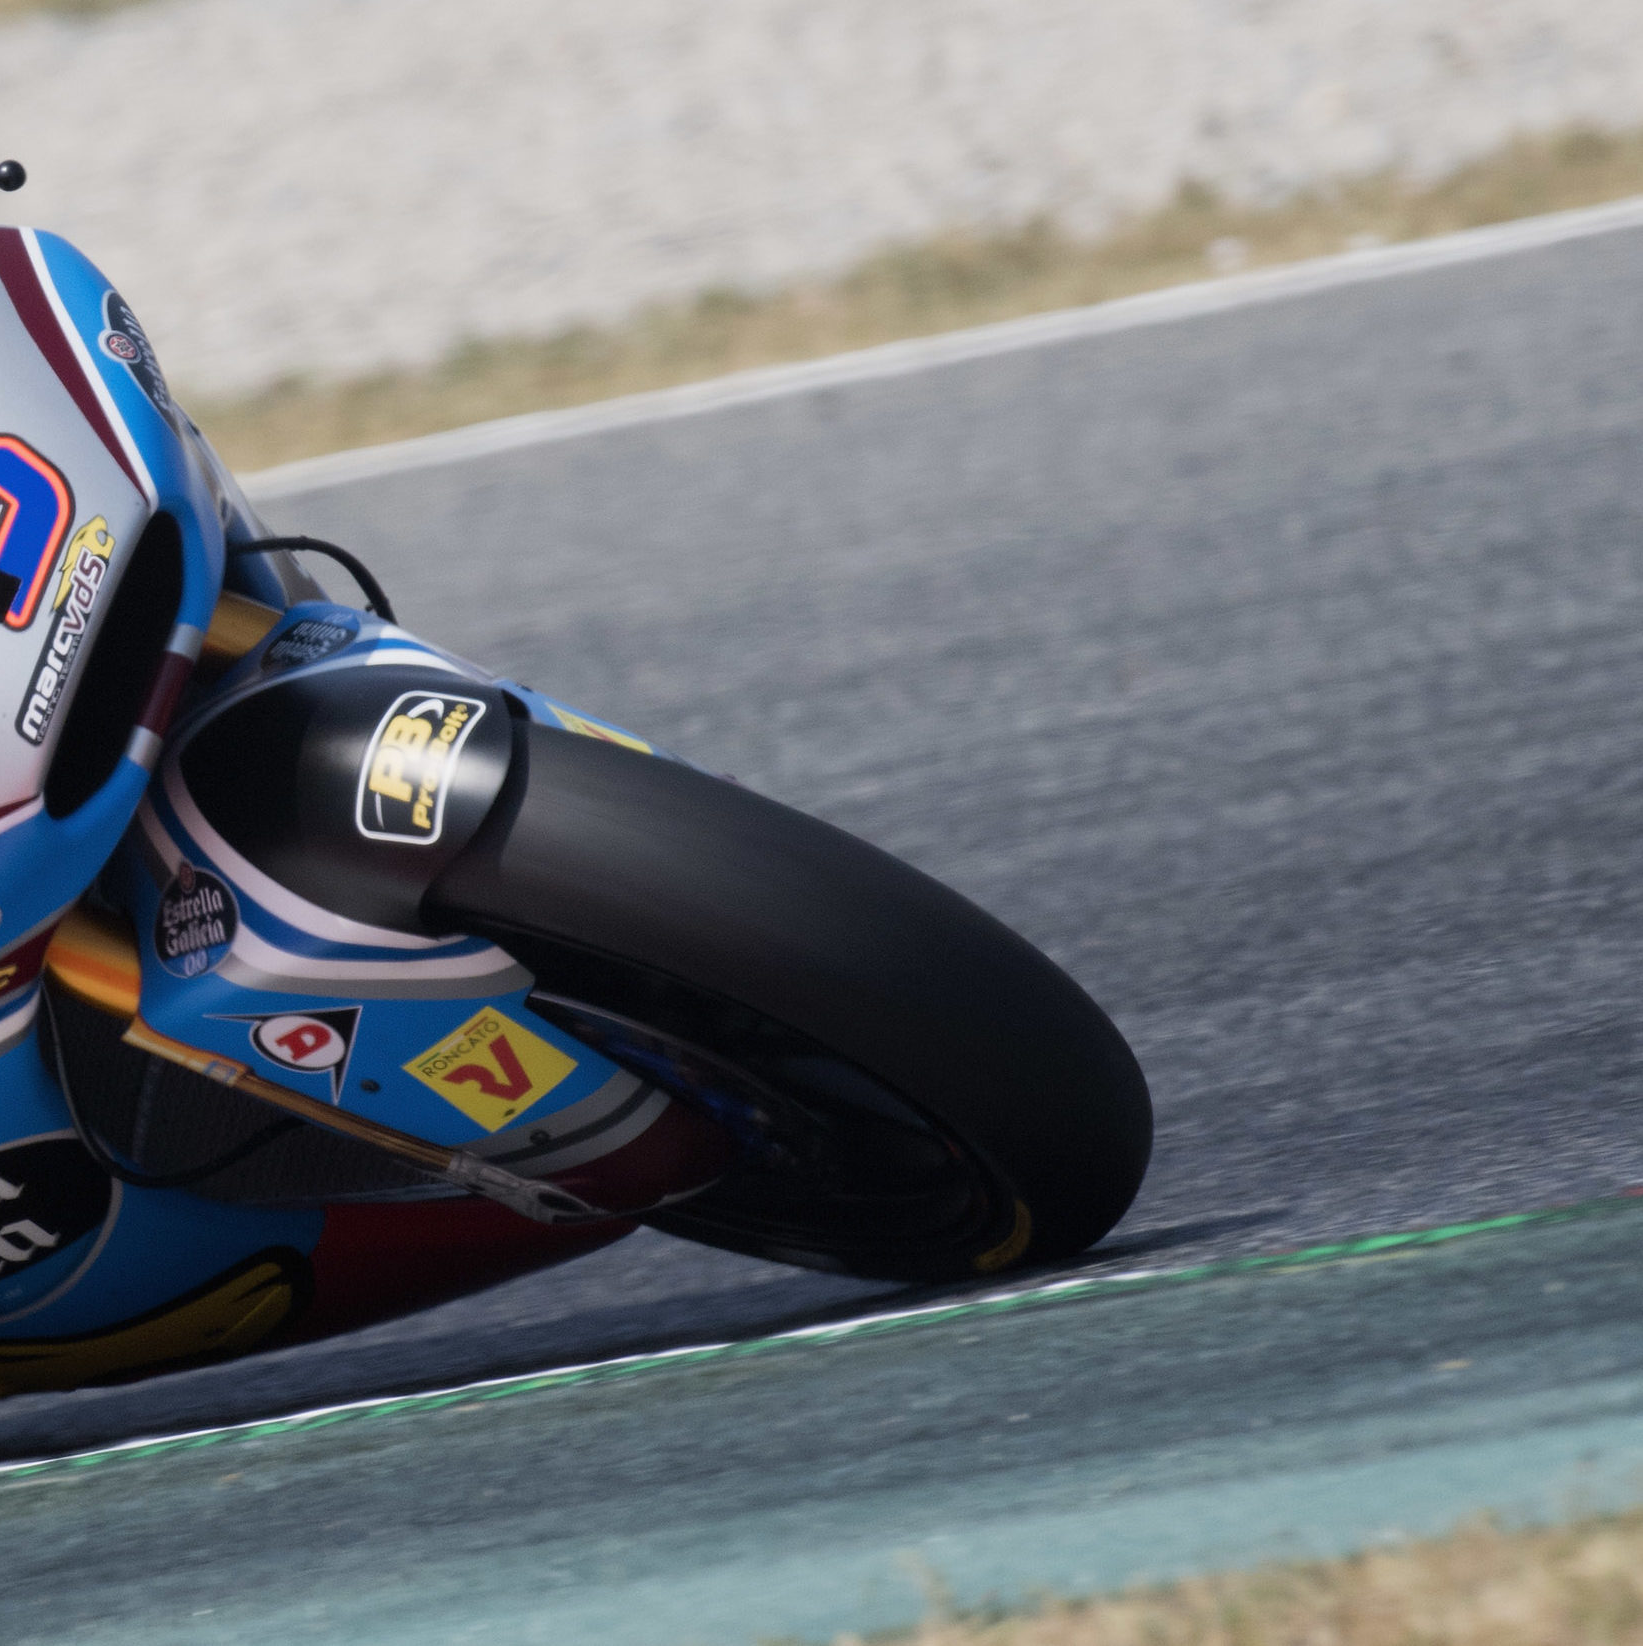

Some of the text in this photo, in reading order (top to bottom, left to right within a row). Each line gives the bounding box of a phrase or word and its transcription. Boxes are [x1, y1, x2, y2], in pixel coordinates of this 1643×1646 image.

[369, 714, 432, 802] PB
[163, 887, 224, 927] Estrella
[166, 915, 226, 956] Galicia
[421, 1020, 500, 1077] RONCATO
